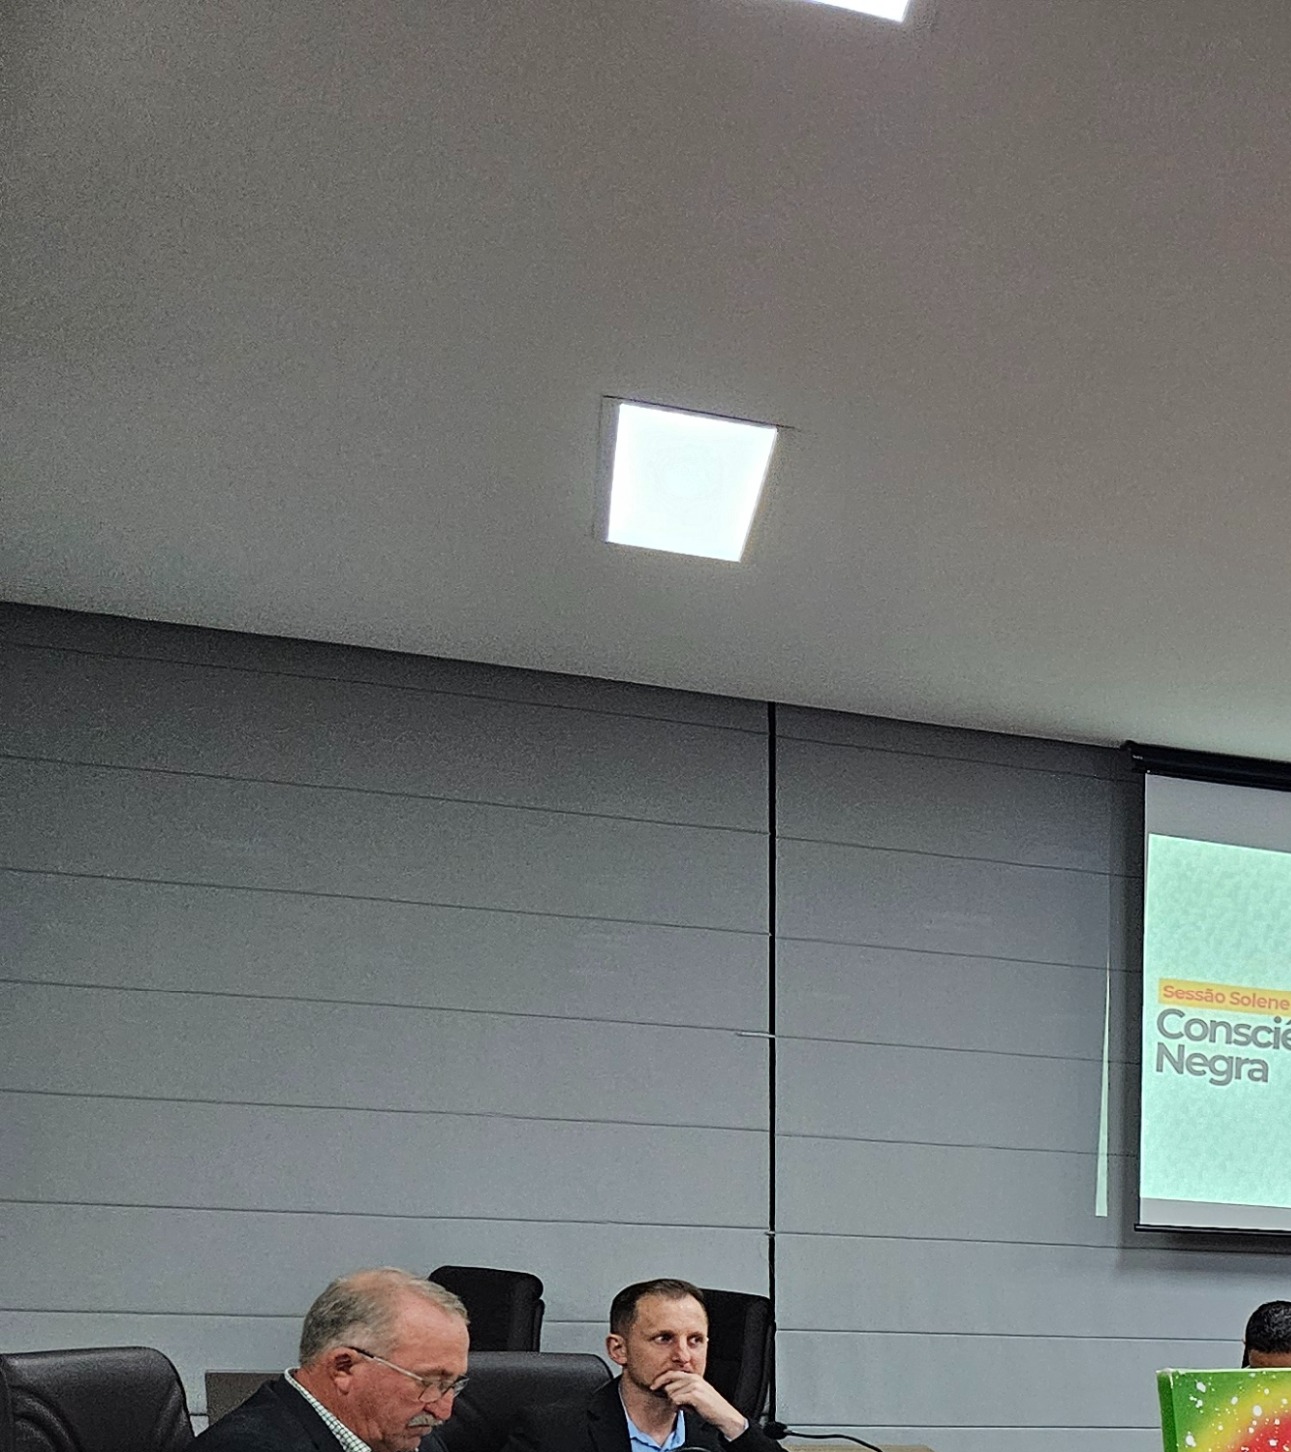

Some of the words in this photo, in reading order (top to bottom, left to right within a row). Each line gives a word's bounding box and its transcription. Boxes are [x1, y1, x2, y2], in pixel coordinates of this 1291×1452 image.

[1163, 985, 1225, 1004] Sessão
[1229, 991, 1290, 1011] Solene
[1155, 1042, 1269, 1086] Negra
